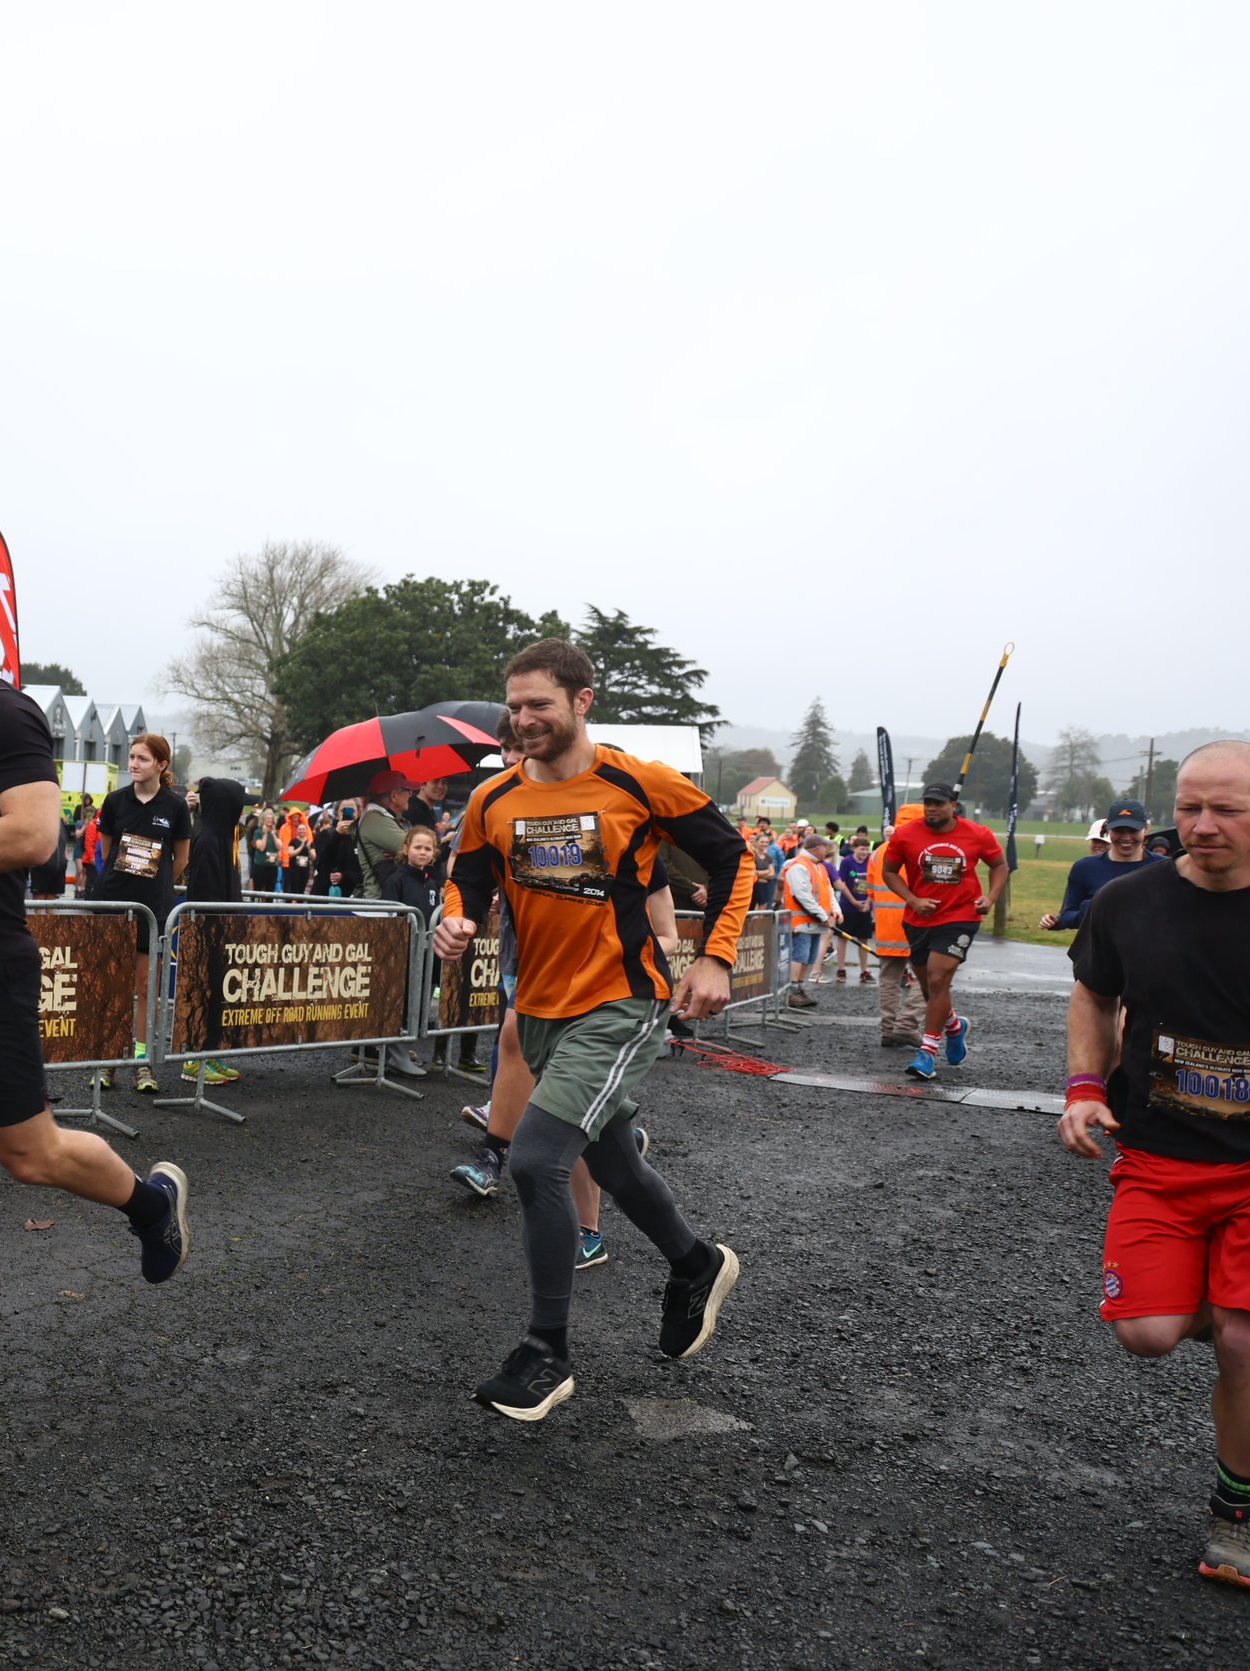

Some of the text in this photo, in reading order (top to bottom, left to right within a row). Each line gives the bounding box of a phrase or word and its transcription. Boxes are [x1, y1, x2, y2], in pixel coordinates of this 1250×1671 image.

[526, 823, 579, 835] CHALLENGE
[528, 843, 583, 869] 10019
[931, 865, 953, 875] 9043
[583, 887, 605, 897] 2014
[225, 942, 373, 965] TOUGH GUY AND GAL
[473, 938, 500, 956] TOUG
[682, 938, 696, 953] GAL
[222, 965, 372, 1004] CHALLENGE
[470, 992, 497, 1007] EXTREME
[222, 1003, 370, 1027] EXTREME OFF ROAD RUNNING EVENT
[38, 1018, 77, 1038] EVENT
[1175, 1040, 1202, 1050] TOUGH
[1202, 1045, 1219, 1053] GUY
[1218, 1048, 1235, 1056] AND
[1176, 1047, 1250, 1066] CHALLENGE
[1175, 1068, 1250, 1103] 10018
